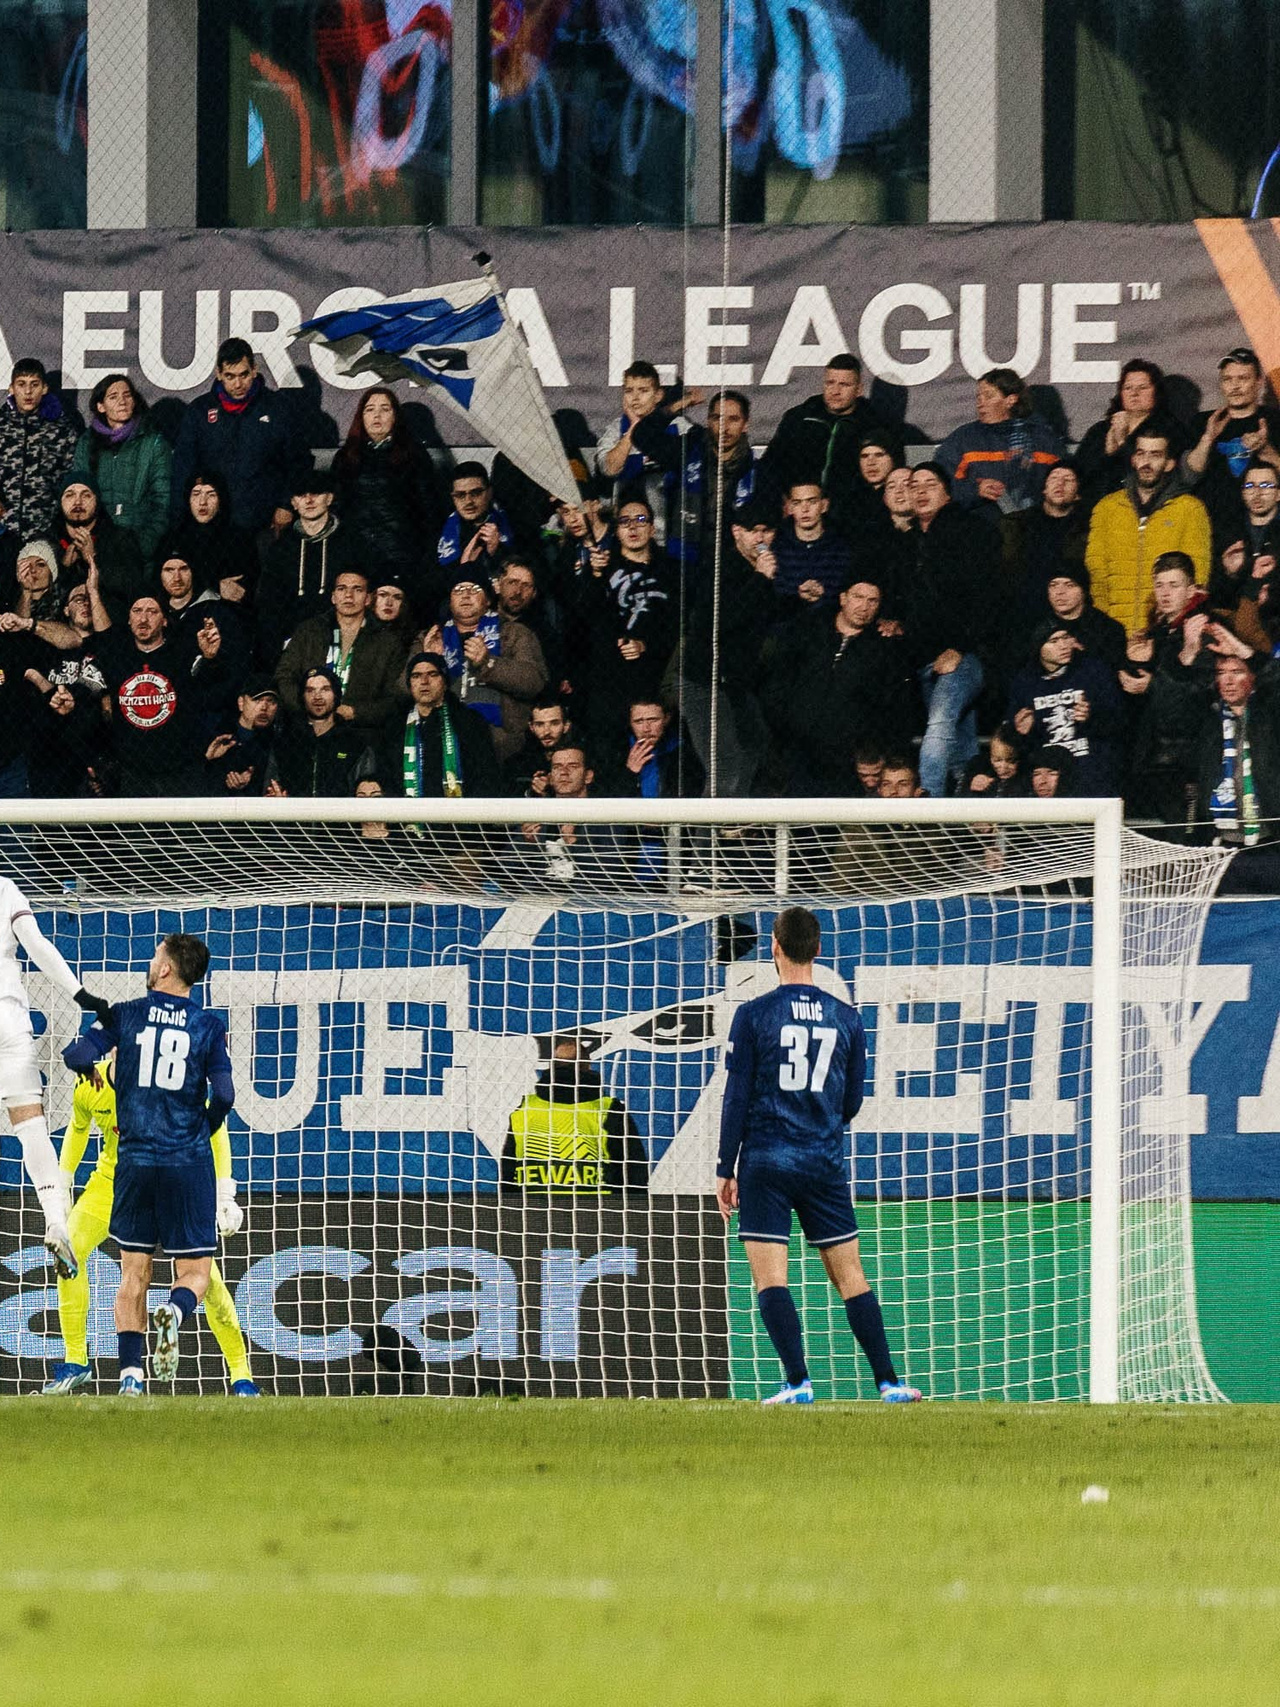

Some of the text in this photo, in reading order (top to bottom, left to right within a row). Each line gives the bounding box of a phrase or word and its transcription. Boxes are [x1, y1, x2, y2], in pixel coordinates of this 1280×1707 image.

[61, 285, 569, 390] EUROA
[608, 282, 1122, 387] LEAGUE
[119, 691, 176, 706] NEMZETI HANG
[148, 1006, 187, 1027] STOJIĆ
[791, 1001, 824, 1022] VULIĆ
[136, 1026, 191, 1091] 18
[779, 1025, 838, 1093] 37
